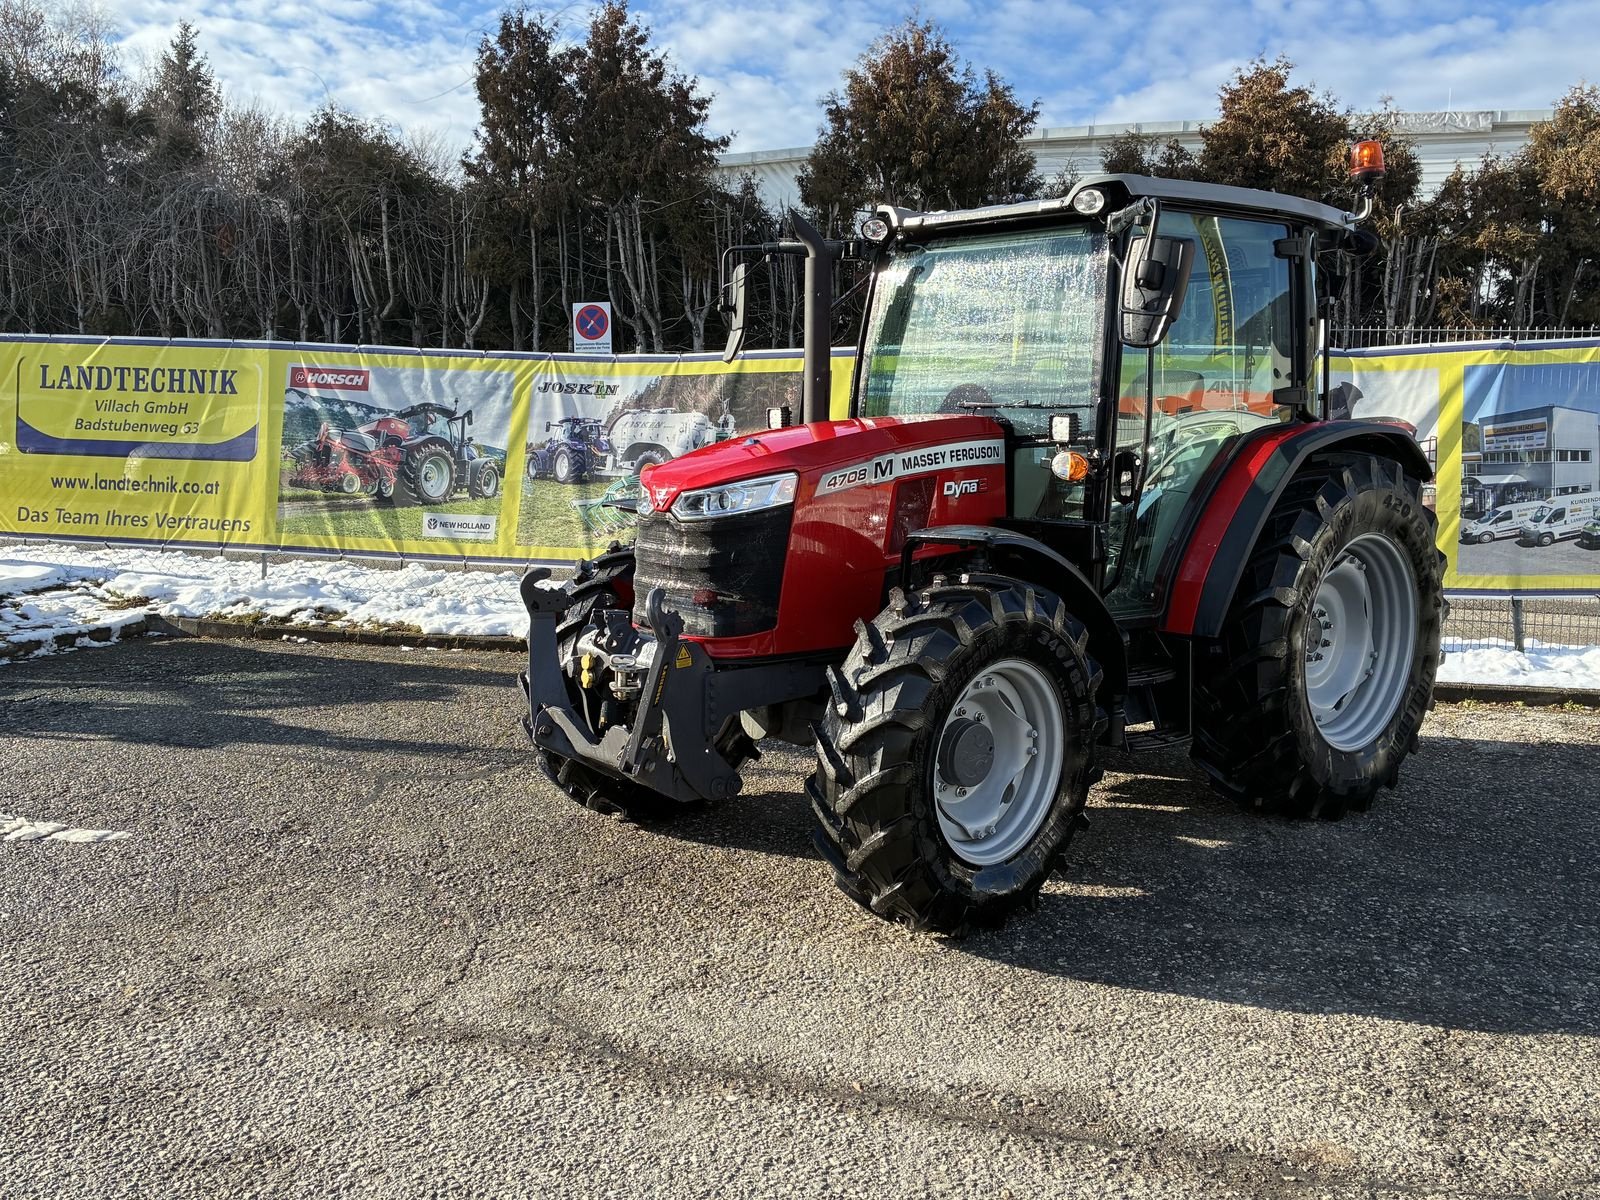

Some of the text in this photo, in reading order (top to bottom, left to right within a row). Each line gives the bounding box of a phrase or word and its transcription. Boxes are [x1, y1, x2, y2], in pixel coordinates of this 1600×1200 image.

[40, 364, 238, 394] LANDTECHNIK
[307, 373, 365, 386] HORSCH
[538, 381, 619, 395] JOSKIN
[95, 399, 188, 414] Villach GmbH
[75, 418, 199, 436] Badstubenweg 63
[826, 445, 1000, 489] 4708 M MASSEY FERGUSON
[51, 473, 220, 495] www.landtechnik.co.at
[17, 507, 251, 532] Das Team Ihres Vertrauens
[439, 521, 491, 530] NEW HOLLAND
